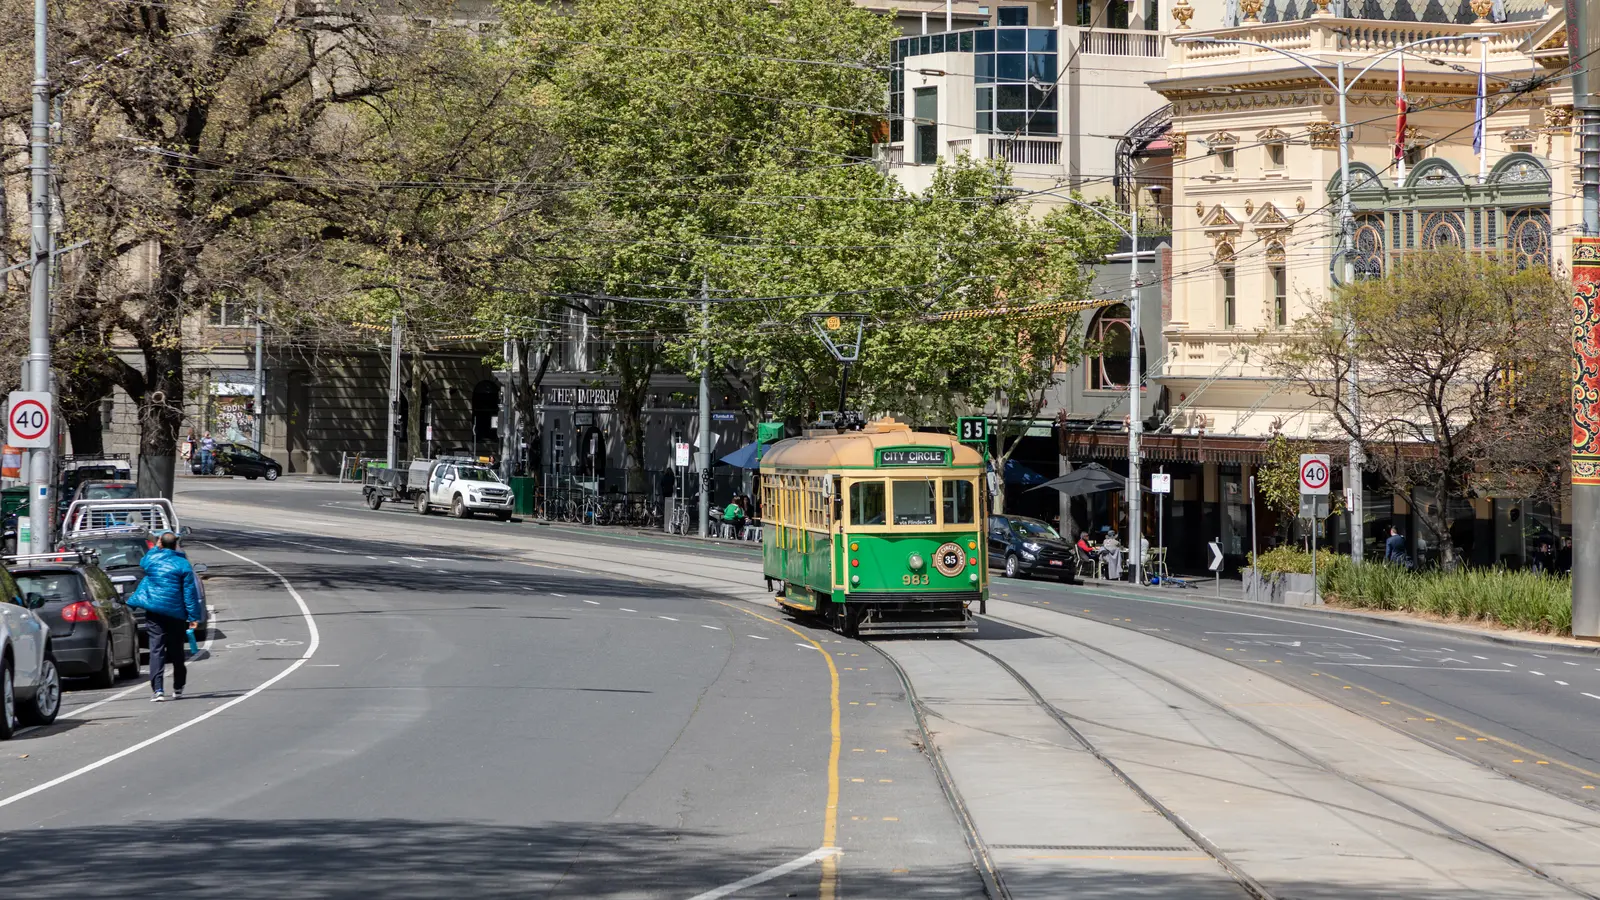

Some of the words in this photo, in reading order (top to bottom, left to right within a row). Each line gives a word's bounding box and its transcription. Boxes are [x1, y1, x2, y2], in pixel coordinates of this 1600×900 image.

[551, 388, 570, 402] THE
[16, 410, 43, 428] 40
[964, 422, 982, 438] 35
[884, 452, 904, 460] CITY
[908, 452, 942, 460] CIRCLE
[1306, 468, 1324, 480] 40
[945, 556, 956, 564] 35
[902, 574, 929, 586] 983
